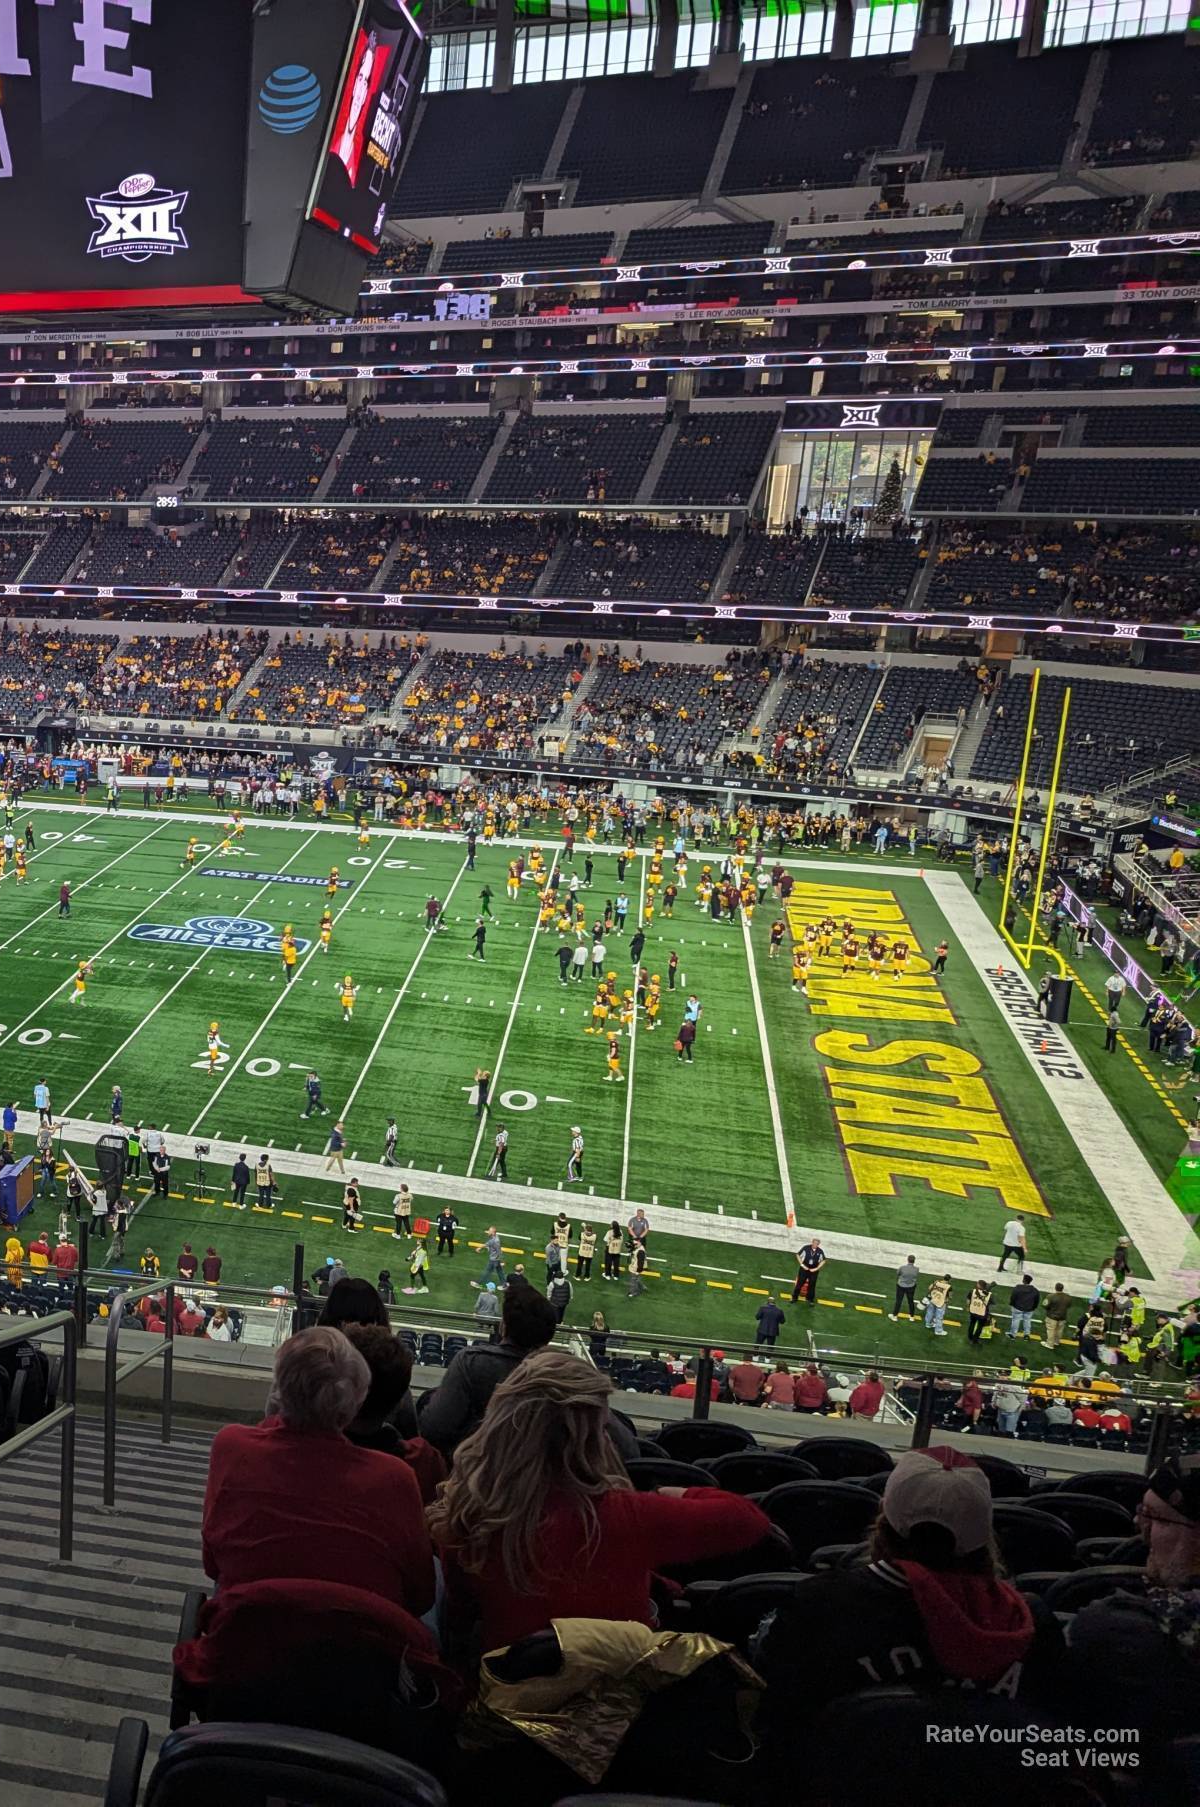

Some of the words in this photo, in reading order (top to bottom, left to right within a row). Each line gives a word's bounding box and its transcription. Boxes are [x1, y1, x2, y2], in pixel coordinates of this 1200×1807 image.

[124, 180, 151, 194] Pepper
[95, 199, 180, 245] XII
[107, 245, 167, 253] CHAMPIONSHIP
[1140, 290, 1169, 298] TONY
[908, 301, 928, 309] TOM
[931, 300, 971, 308] LANDRY
[706, 310, 722, 318] ROY
[725, 308, 758, 317] JORDAN
[519, 318, 557, 326] STAUBACH
[1080, 826, 1096, 834] ESPN
[40, 832, 96, 844] 40
[346, 856, 409, 870] 20
[202, 869, 254, 879] AT&T
[1112, 878, 1125, 898] ESPN
[984, 966, 1046, 1021] GREATER
[1016, 1022, 1072, 1058] THAN
[190, 1051, 283, 1078] 20
[1038, 1059, 1084, 1080] 12
[814, 1028, 1052, 1219] STATE
